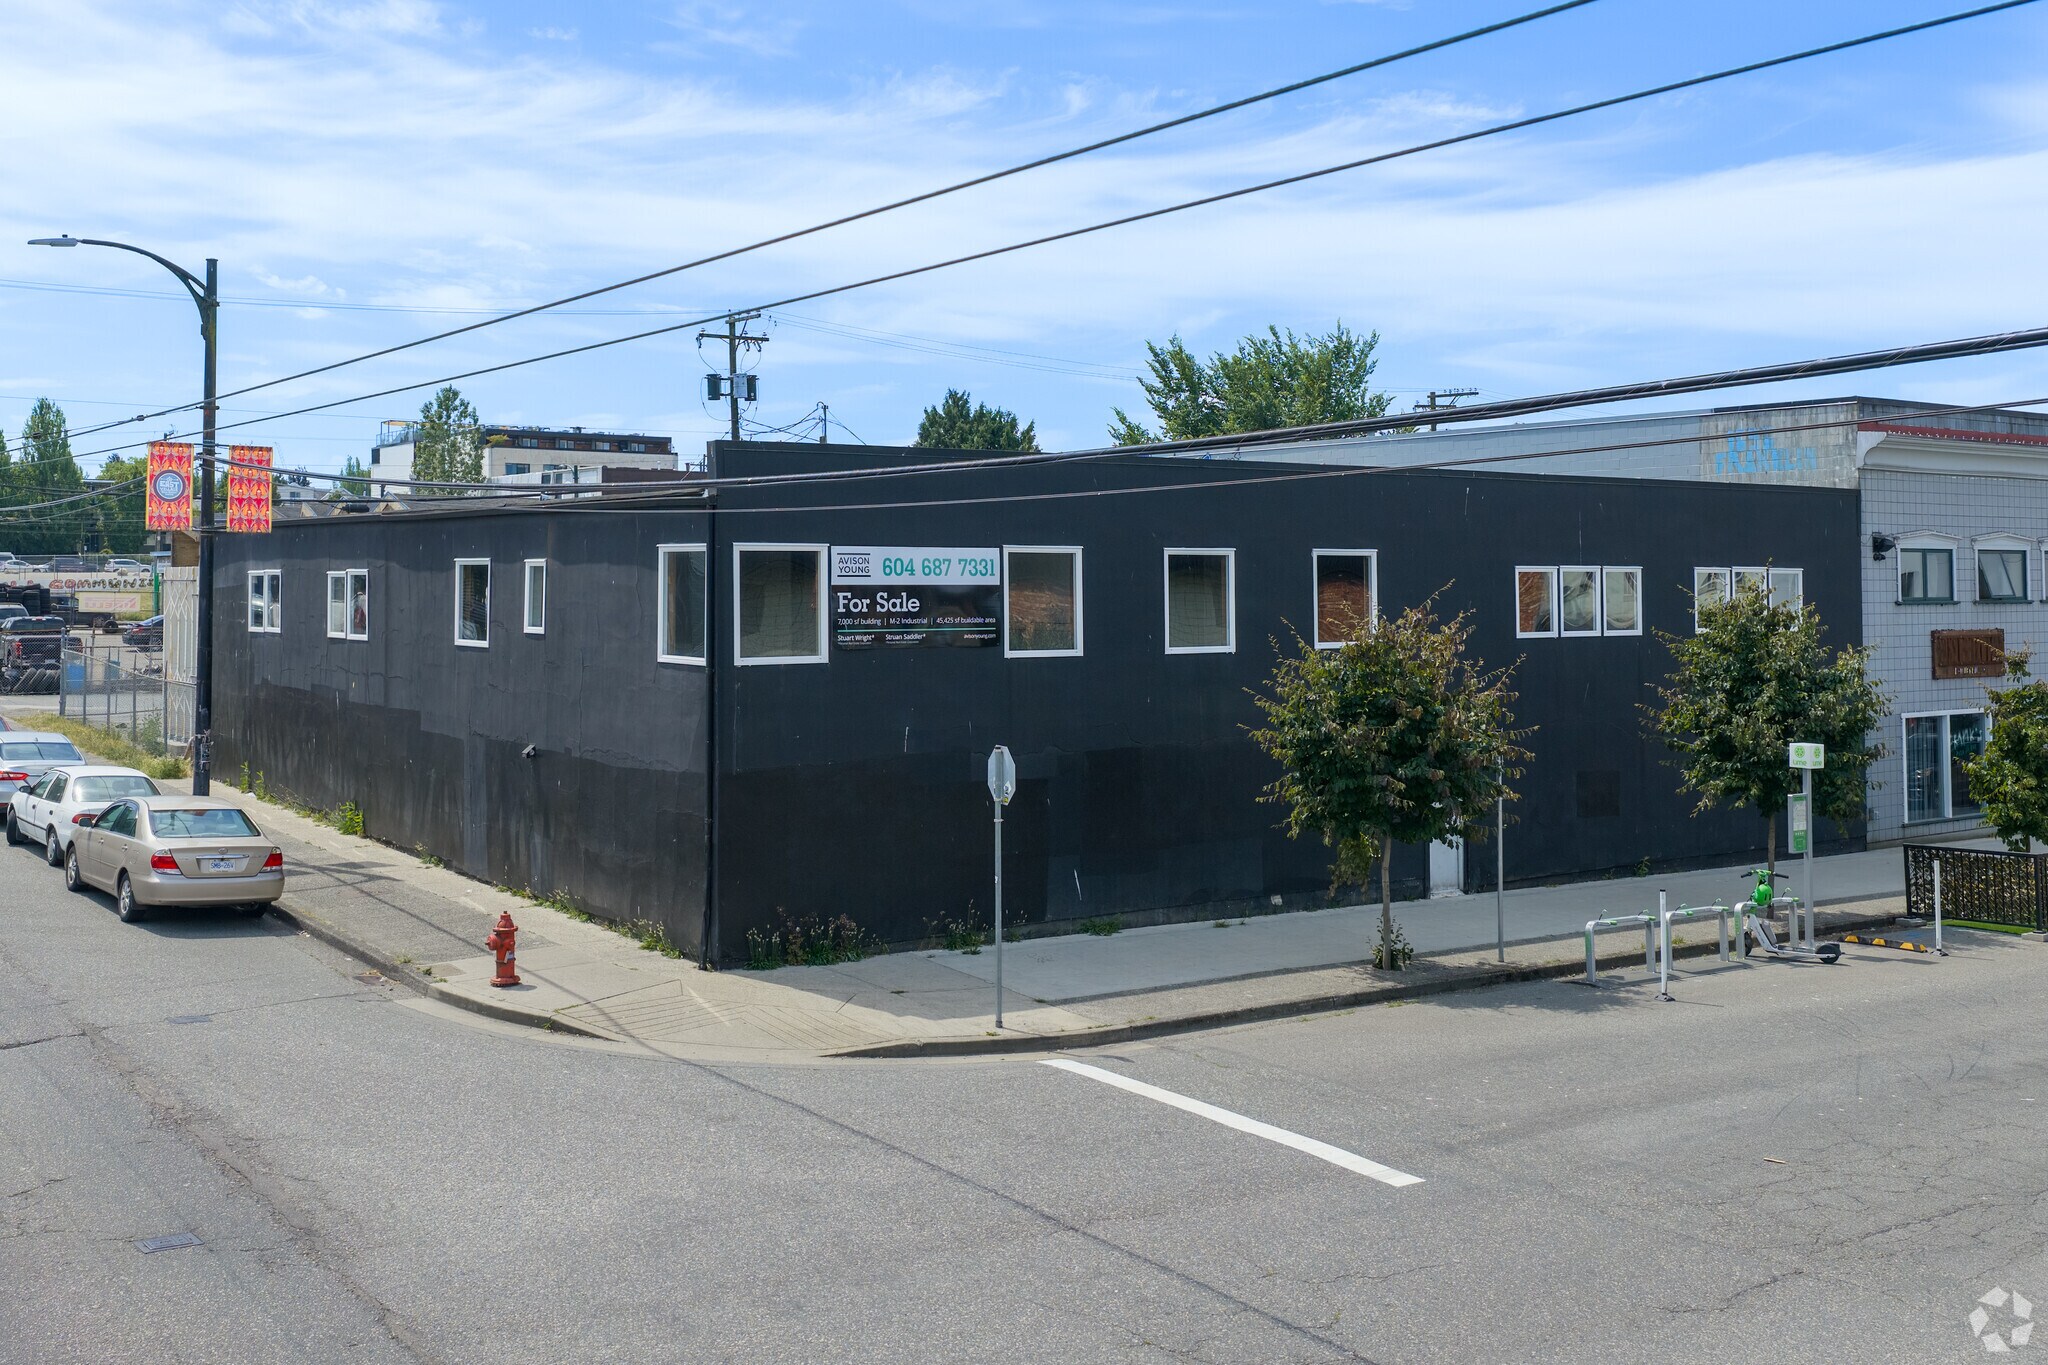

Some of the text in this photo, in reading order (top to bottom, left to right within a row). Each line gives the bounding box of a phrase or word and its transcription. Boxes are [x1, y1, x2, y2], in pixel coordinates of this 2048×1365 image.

[160, 480, 180, 489] EAST
[838, 556, 870, 565] AVISON
[838, 566, 870, 574] YOUNG
[882, 557, 996, 577] 604 687 7331
[837, 591, 920, 613] For Sale
[837, 618, 853, 626] 7,000
[860, 617, 882, 626] building
[889, 617, 900, 625] M-2
[901, 617, 928, 625] Industrial
[936, 617, 954, 625] 45,425
[961, 616, 984, 624] buildable
[837, 634, 855, 642] Stuart
[885, 633, 902, 641] Struan
